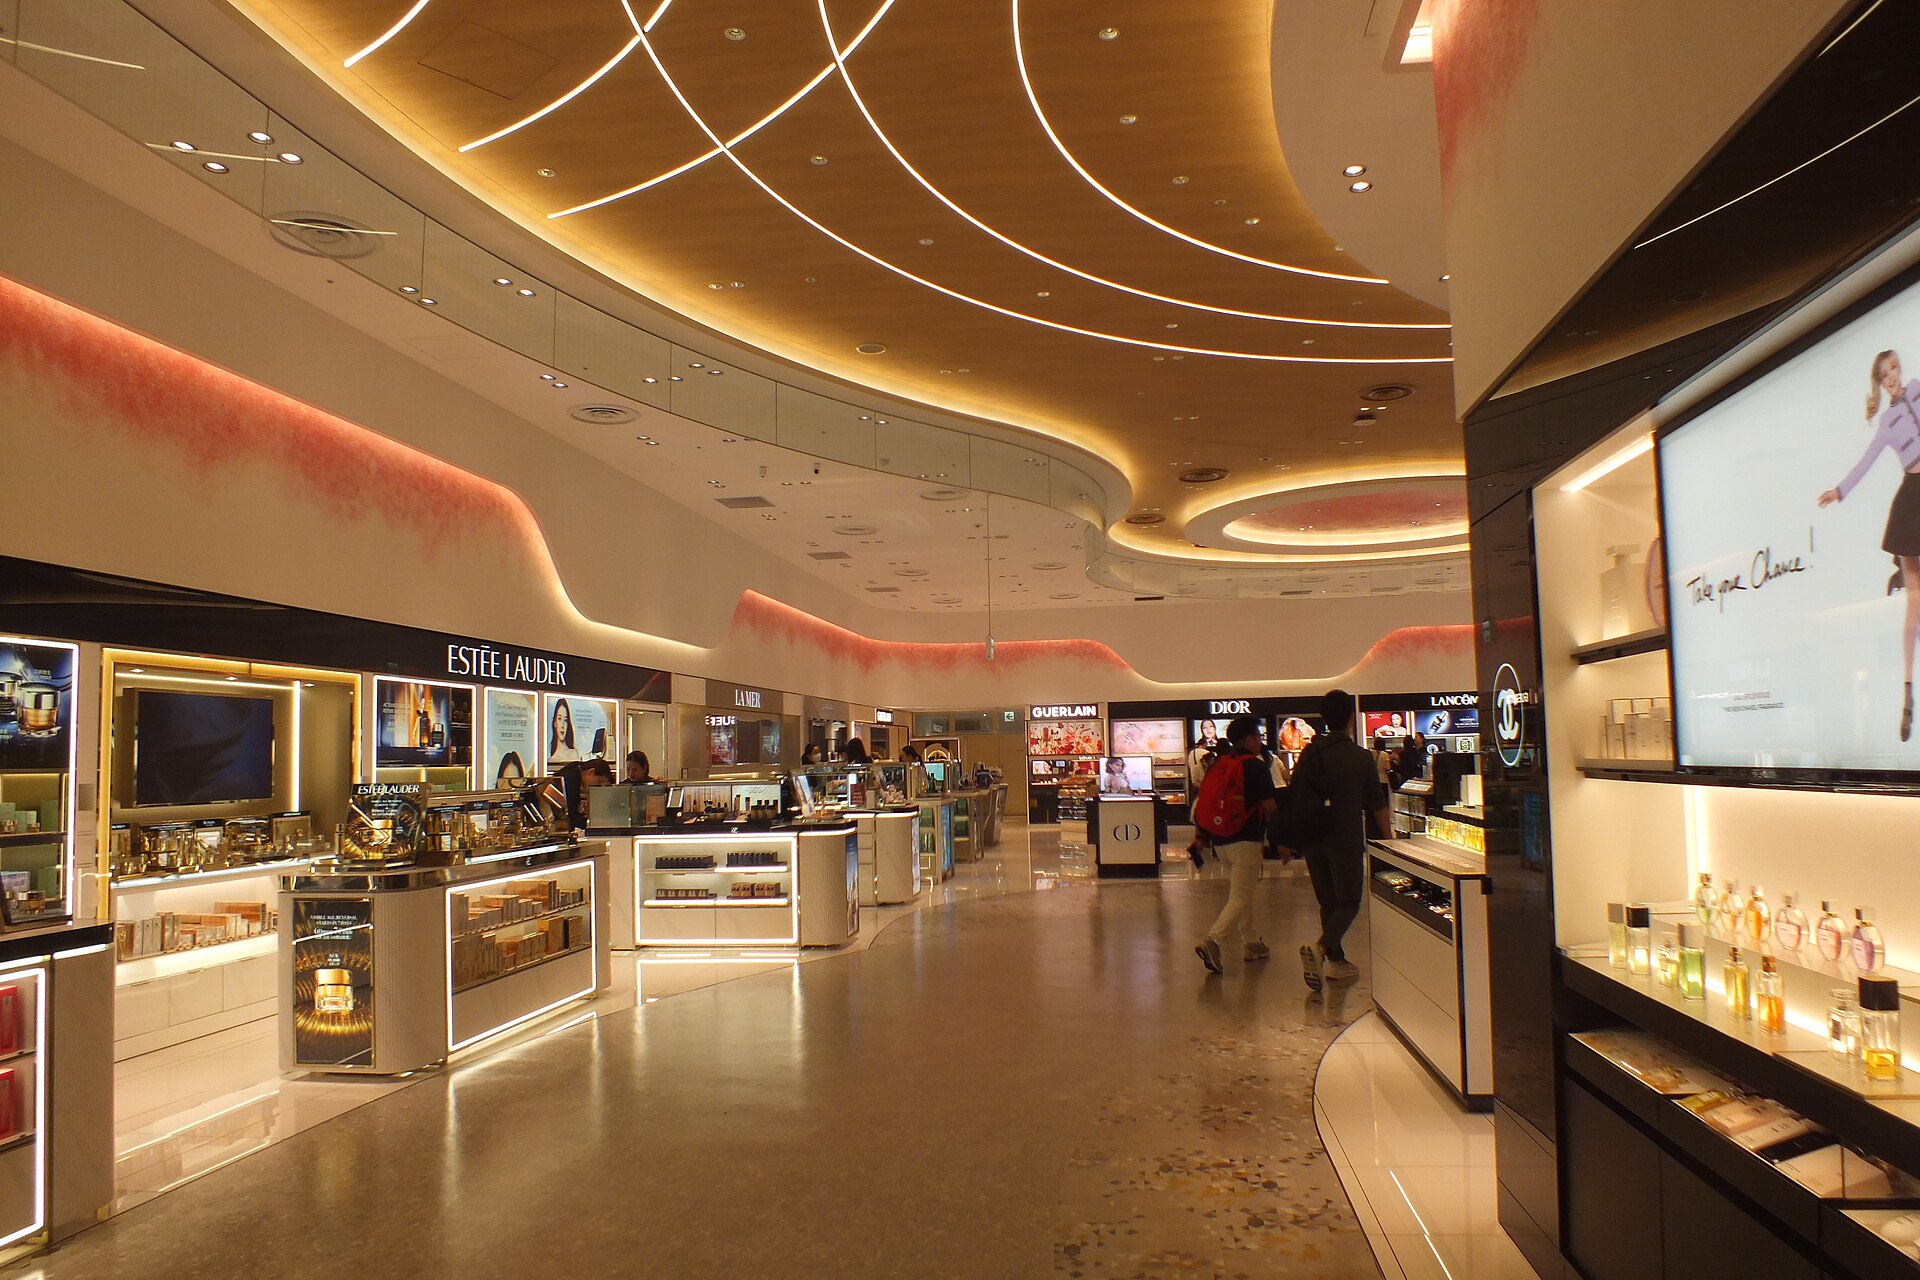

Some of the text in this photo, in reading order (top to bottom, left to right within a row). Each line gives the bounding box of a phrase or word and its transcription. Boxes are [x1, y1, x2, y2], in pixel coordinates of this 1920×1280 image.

[1686, 572, 1714, 607] Take
[1717, 574, 1747, 614] your
[505, 653, 567, 686] LAUDER
[735, 689, 761, 708] LA MER
[1430, 694, 1479, 707] LANCÔM
[1032, 706, 1097, 718] GUERLAIN
[1210, 700, 1252, 715] DIOR
[385, 784, 420, 793] LAUDER
